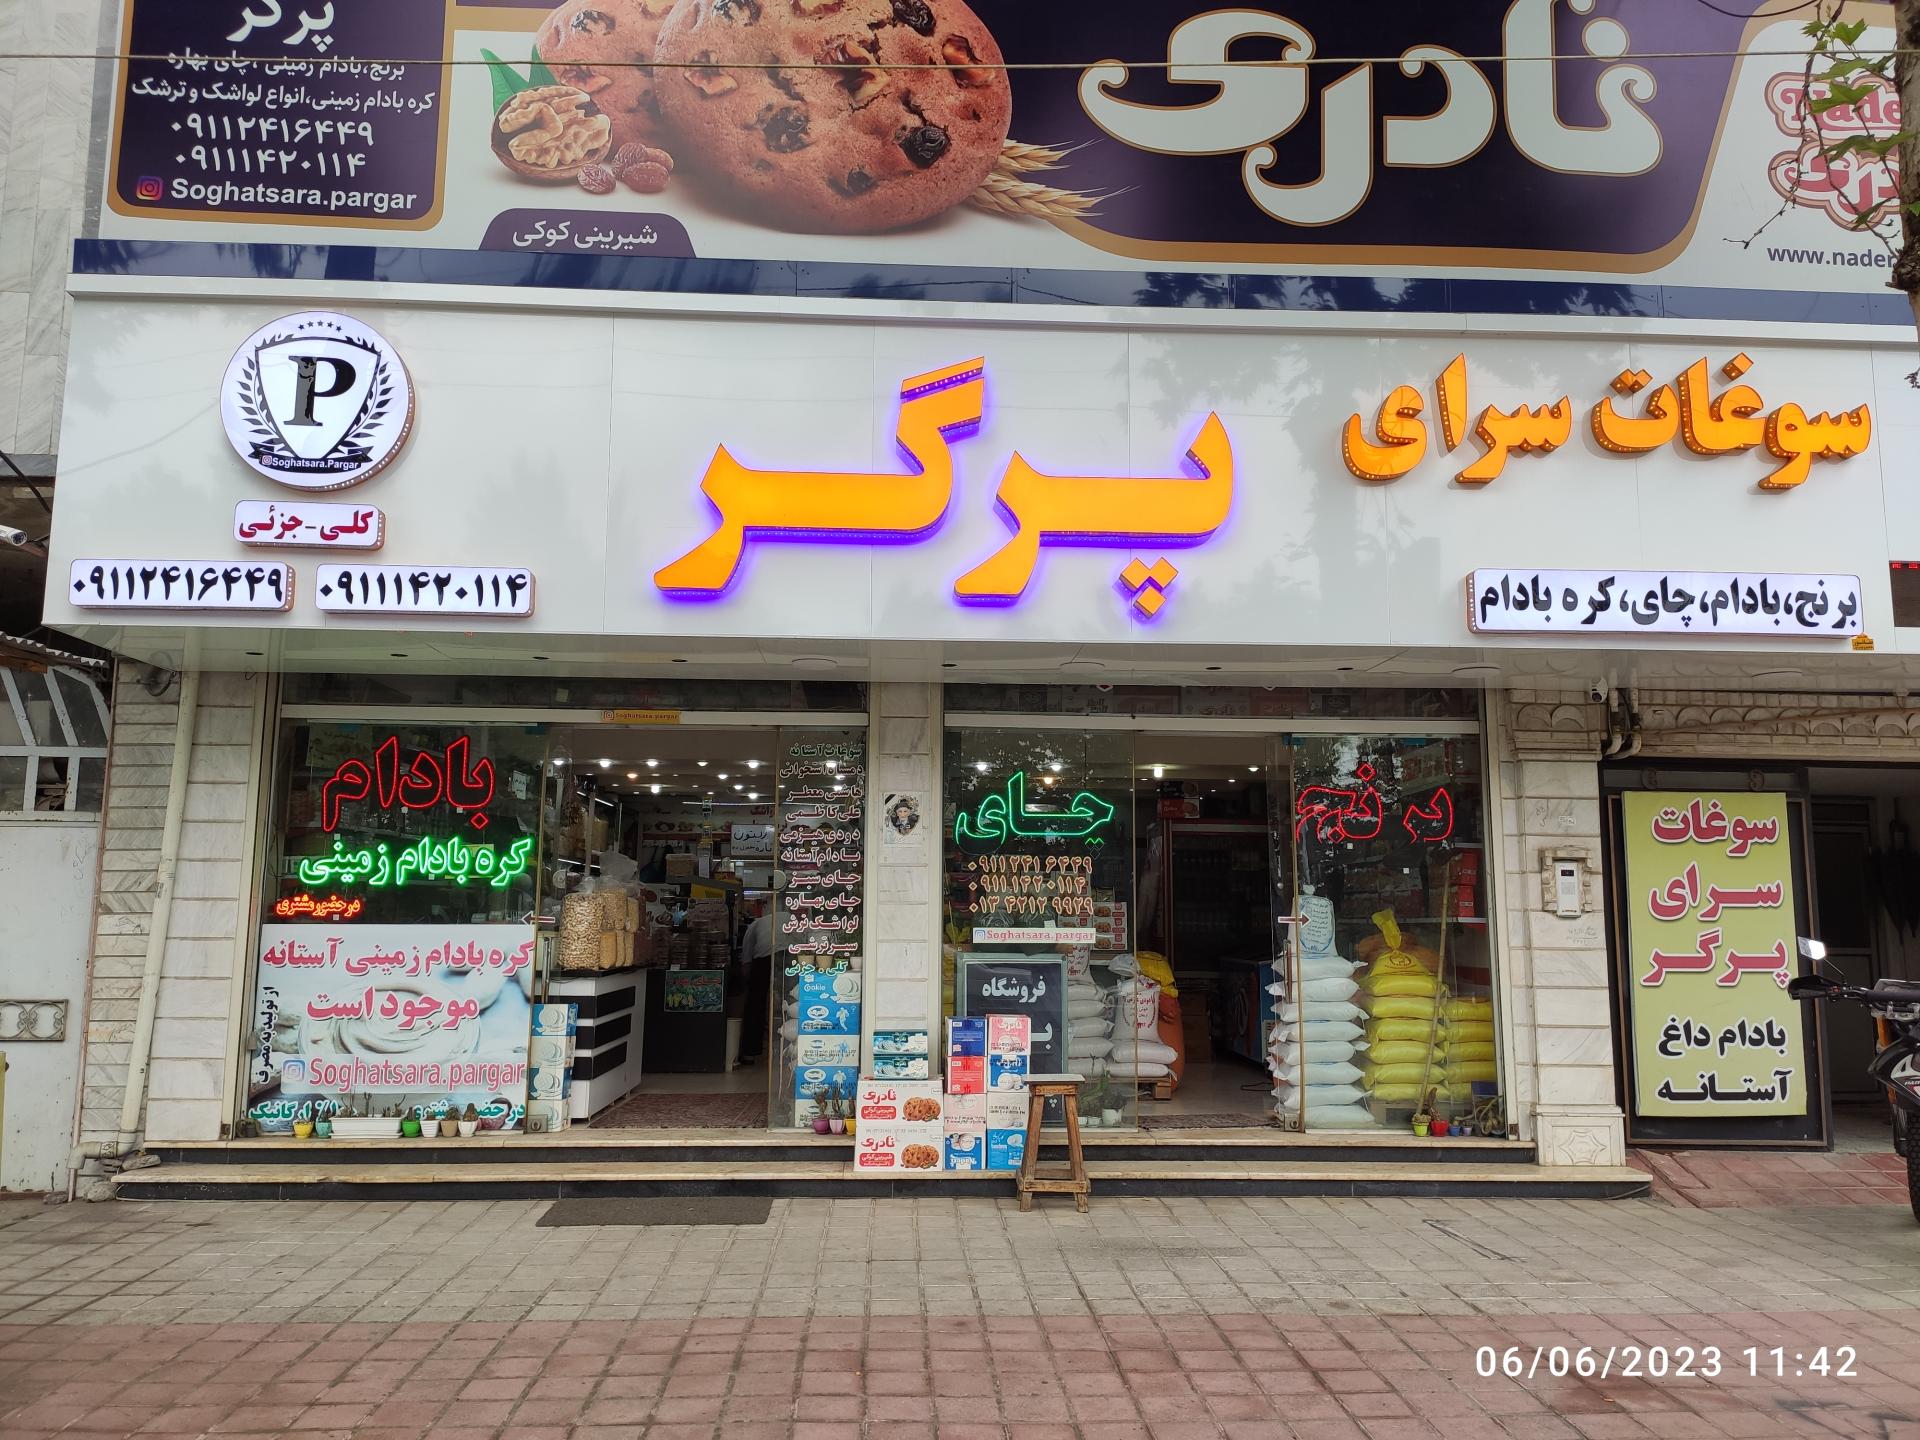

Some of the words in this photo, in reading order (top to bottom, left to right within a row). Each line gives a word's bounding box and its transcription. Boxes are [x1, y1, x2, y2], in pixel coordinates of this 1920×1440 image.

[131, 77, 186, 102] ترشک
[189, 88, 199, 103] و
[202, 82, 263, 105] لواشک
[264, 86, 305, 110] انواع
[362, 91, 404, 114] بادام
[407, 92, 436, 114] کره
[1779, 85, 1902, 132] Nade
[171, 112, 375, 146] ۰۹۱۱۲۴۱۶۴۴۹
[175, 144, 367, 178] ۰۹۱۱۱۴۲۰۱۱۴
[170, 177, 417, 214] Soghatsara.pargar
[512, 220, 571, 248] کوکی
[574, 224, 658, 250] شیرینی
[1766, 246, 1898, 268] www.nader
[284, 355, 357, 426] P
[1342, 352, 1572, 483] سرای
[1591, 352, 1873, 490] سوغات
[272, 458, 359, 470] Soghatsara.Pargar
[652, 355, 1236, 622] پرگر
[73, 565, 283, 604] ۰۹۱۱۲۴۱۶۴۴۹
[320, 570, 528, 609] ۰۹۱۱۱۴۲۰۱۱۴
[1479, 574, 1553, 624] بادام
[1562, 575, 1616, 625] کره
[320, 735, 495, 832] بادام
[785, 802, 839, 822] کاظمی
[837, 804, 862, 821] علی
[956, 770, 1115, 858] چای
[1651, 798, 1780, 856] سوغات
[779, 826, 826, 846] هیزمی
[825, 828, 861, 844] دودی
[299, 839, 390, 886] زمینی
[395, 835, 470, 886] بادام
[474, 836, 534, 887] کره
[780, 846, 820, 863] آستانه
[817, 847, 861, 867] بادام
[788, 870, 821, 890] سبز
[821, 869, 862, 890] چای
[1649, 861, 1784, 921] سرای
[785, 892, 825, 911] بهاره
[825, 892, 862, 913] چای
[808, 914, 860, 934] لواشک
[263, 936, 343, 968] آستانه
[344, 943, 422, 977] زمینی
[425, 940, 484, 976] بادام
[487, 939, 535, 976] کره
[1640, 929, 1790, 989] پرگر
[306, 985, 376, 1021] است
[981, 975, 1047, 1004] فروشگاه
[382, 989, 481, 1031] موجود
[1657, 1015, 1712, 1057] داغ
[1717, 1017, 1788, 1057] بادام
[308, 1056, 526, 1092] Soghatsara.pargar
[1656, 1069, 1794, 1103] آستانه
[862, 1088, 897, 1105] نادری
[860, 1135, 895, 1152] نادری
